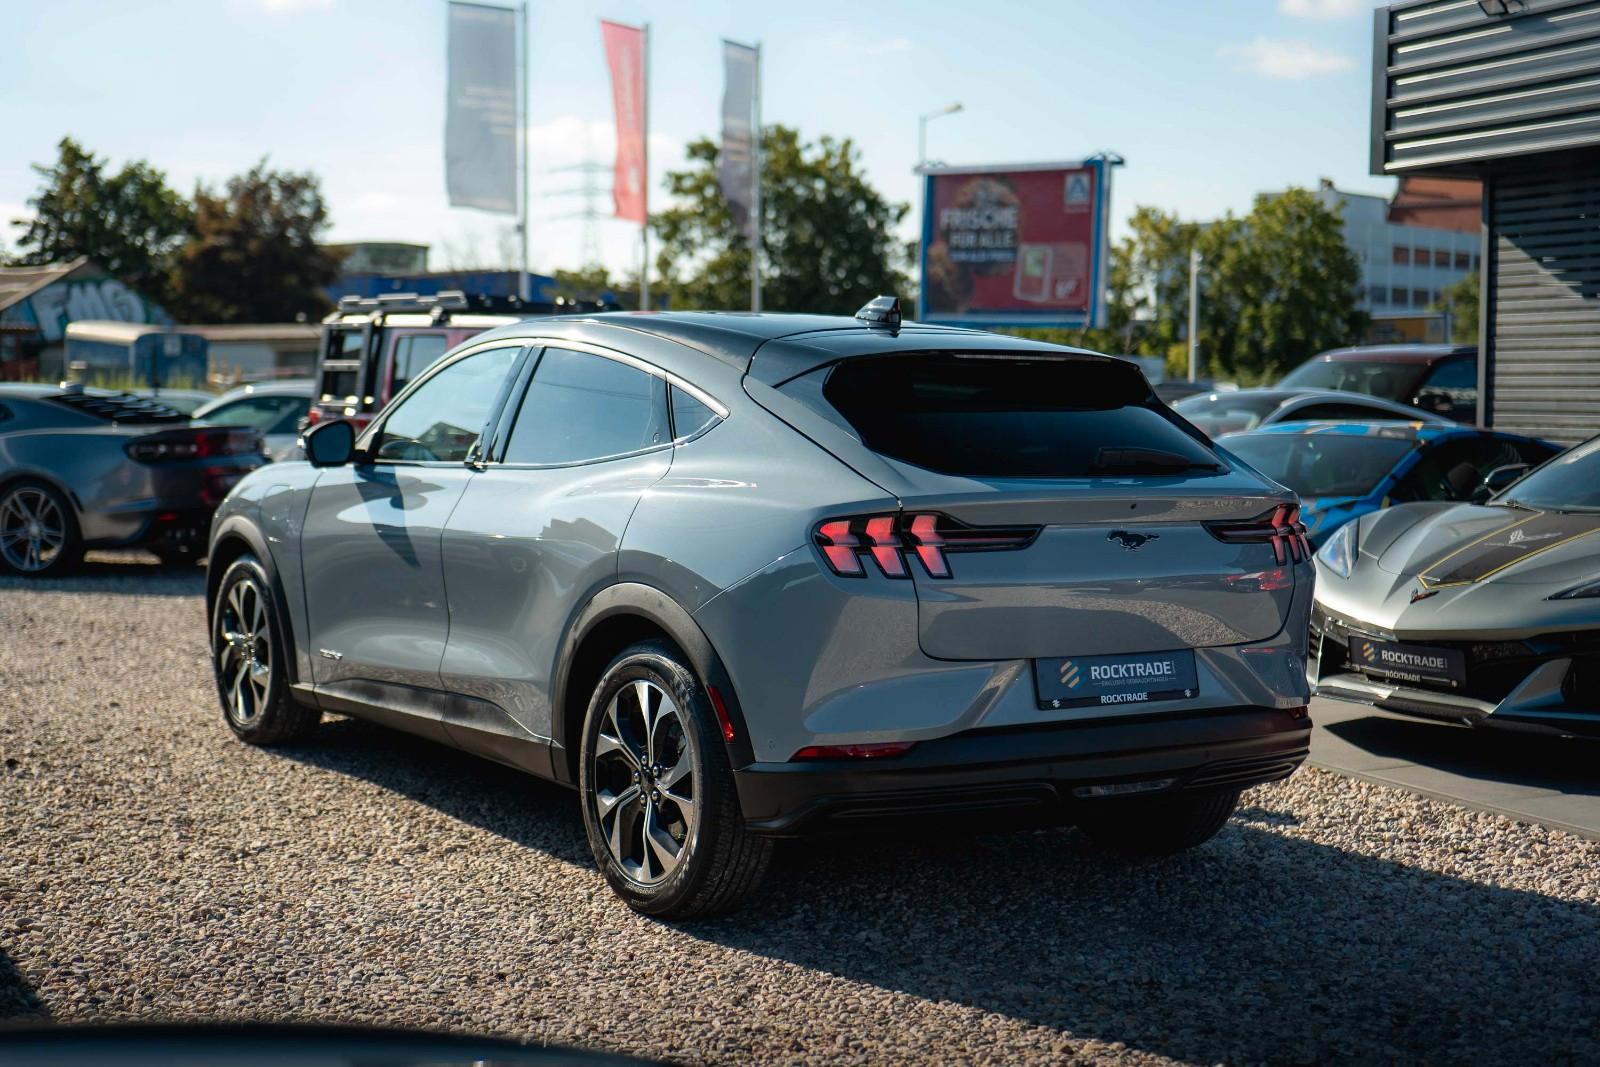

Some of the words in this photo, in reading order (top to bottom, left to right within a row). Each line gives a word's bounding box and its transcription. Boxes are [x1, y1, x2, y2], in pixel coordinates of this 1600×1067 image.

[1381, 650, 1444, 668] ROCKTRADE
[1091, 661, 1171, 679] ROCKTRADE
[1385, 670, 1421, 682] ROCKTRADE
[1101, 692, 1148, 704] ROCKTRADE
